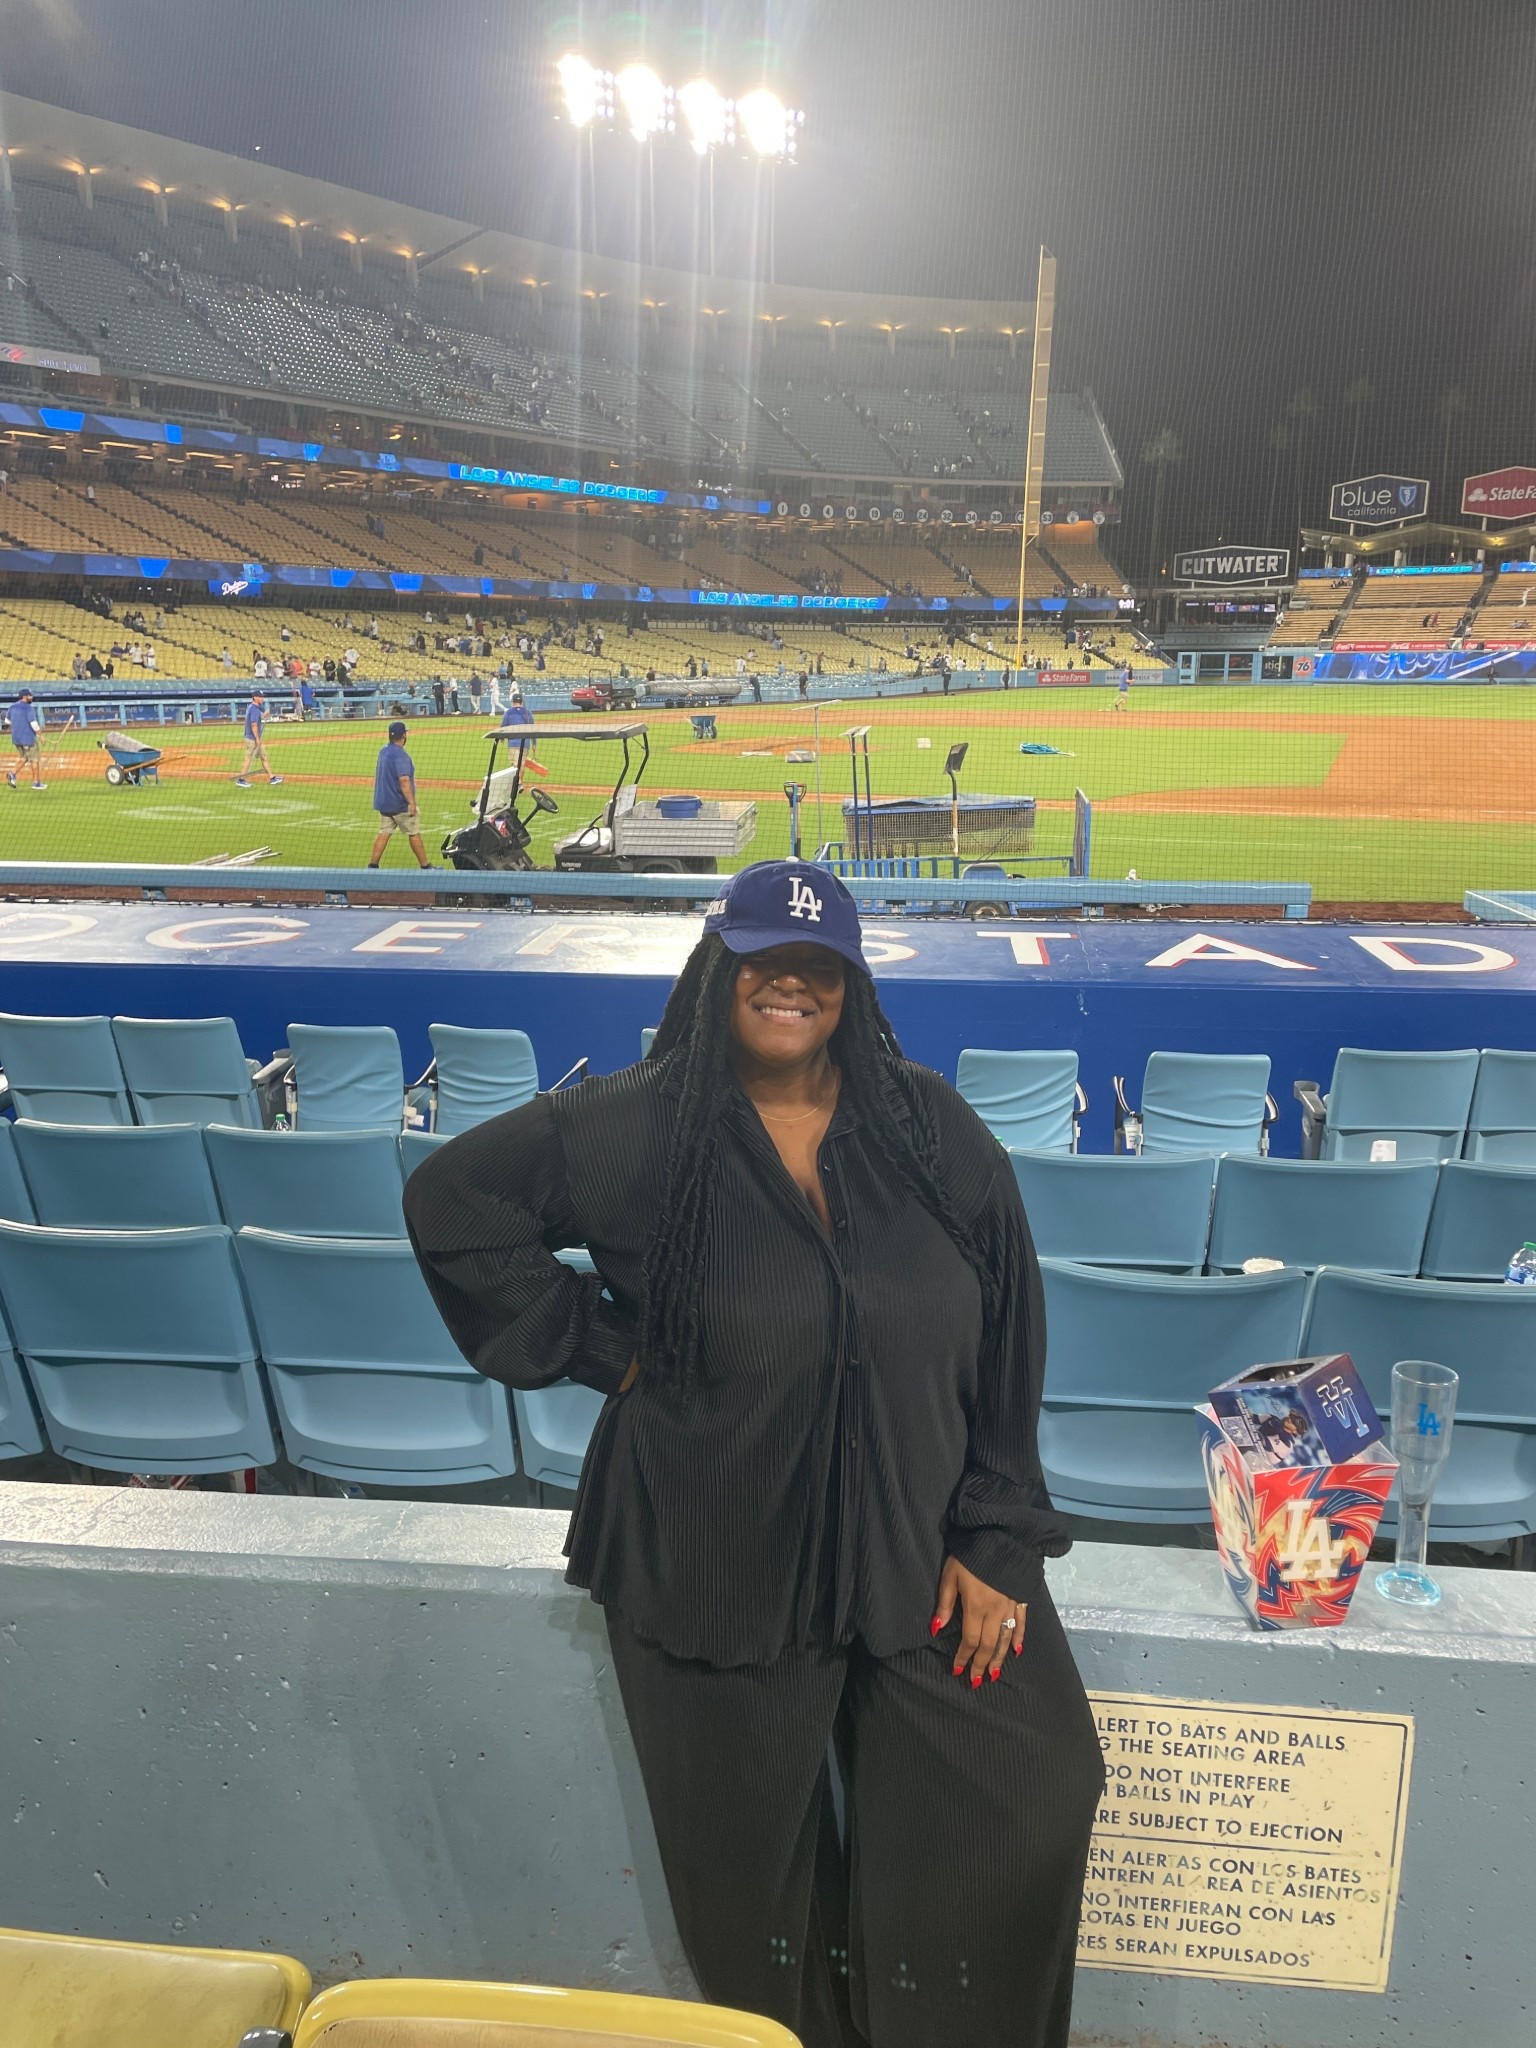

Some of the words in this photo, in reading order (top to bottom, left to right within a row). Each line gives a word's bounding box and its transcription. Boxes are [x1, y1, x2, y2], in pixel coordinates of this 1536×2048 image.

[460, 466, 498, 482] LOS
[501, 471, 580, 494] ANGELES
[583, 481, 659, 502] DODGERS
[1340, 485, 1392, 506] blue
[846, 509, 856, 518] 14
[894, 511, 903, 519] 20
[918, 512, 927, 521] 24
[942, 512, 951, 521] 32
[967, 513, 976, 521] 34
[1347, 507, 1397, 517] california
[1182, 555, 1279, 575] CUTWATER
[699, 591, 728, 604] LOS
[730, 593, 798, 608] ANGELES
[801, 595, 879, 609] DODGERS
[1296, 661, 1310, 671] 76
[788, 877, 823, 922] LA
[1315, 1375, 1370, 1438] LA
[1416, 1402, 1441, 1436] LA
[1279, 1498, 1344, 1582] LA
[1098, 1717, 1138, 1734] LERT
[1146, 1721, 1172, 1736] TO
[1181, 1723, 1226, 1741] BATS
[1235, 1728, 1280, 1745] AND
[1289, 1732, 1346, 1750] BALLS
[1119, 1738, 1153, 1754] THE
[1162, 1741, 1245, 1761] SEATING
[1253, 1749, 1306, 1767] AREA
[1105, 1764, 1132, 1779] DO
[1141, 1767, 1182, 1783] NOT
[1191, 1771, 1290, 1793] INTERFERE
[1116, 1783, 1171, 1801] BALLS
[1180, 1789, 1200, 1804] IN
[1209, 1791, 1255, 1808] PLAY
[1129, 1811, 1208, 1831] SUBJECT
[1216, 1819, 1242, 1834] TO
[1250, 1822, 1343, 1843] EJECTION
[1089, 1847, 1114, 1863] EN
[1122, 1851, 1202, 1870] ALERTAS
[1209, 1858, 1254, 1875] CON
[1305, 1865, 1361, 1884] BATES
[1162, 1873, 1185, 1887] AL
[1252, 1880, 1275, 1895] DE
[1282, 1883, 1380, 1903] ASIENTOS
[1082, 1892, 1110, 1907] NO
[1118, 1894, 1241, 1918] INTERFIERAN
[1249, 1906, 1293, 1922] CON
[1302, 1911, 1336, 1926] LAS
[1144, 1915, 1169, 1930] EN
[1176, 1918, 1241, 1936] JUEGO
[1116, 1938, 1177, 1956] SERAN
[1186, 1944, 1310, 1967] EXPULSADOS
